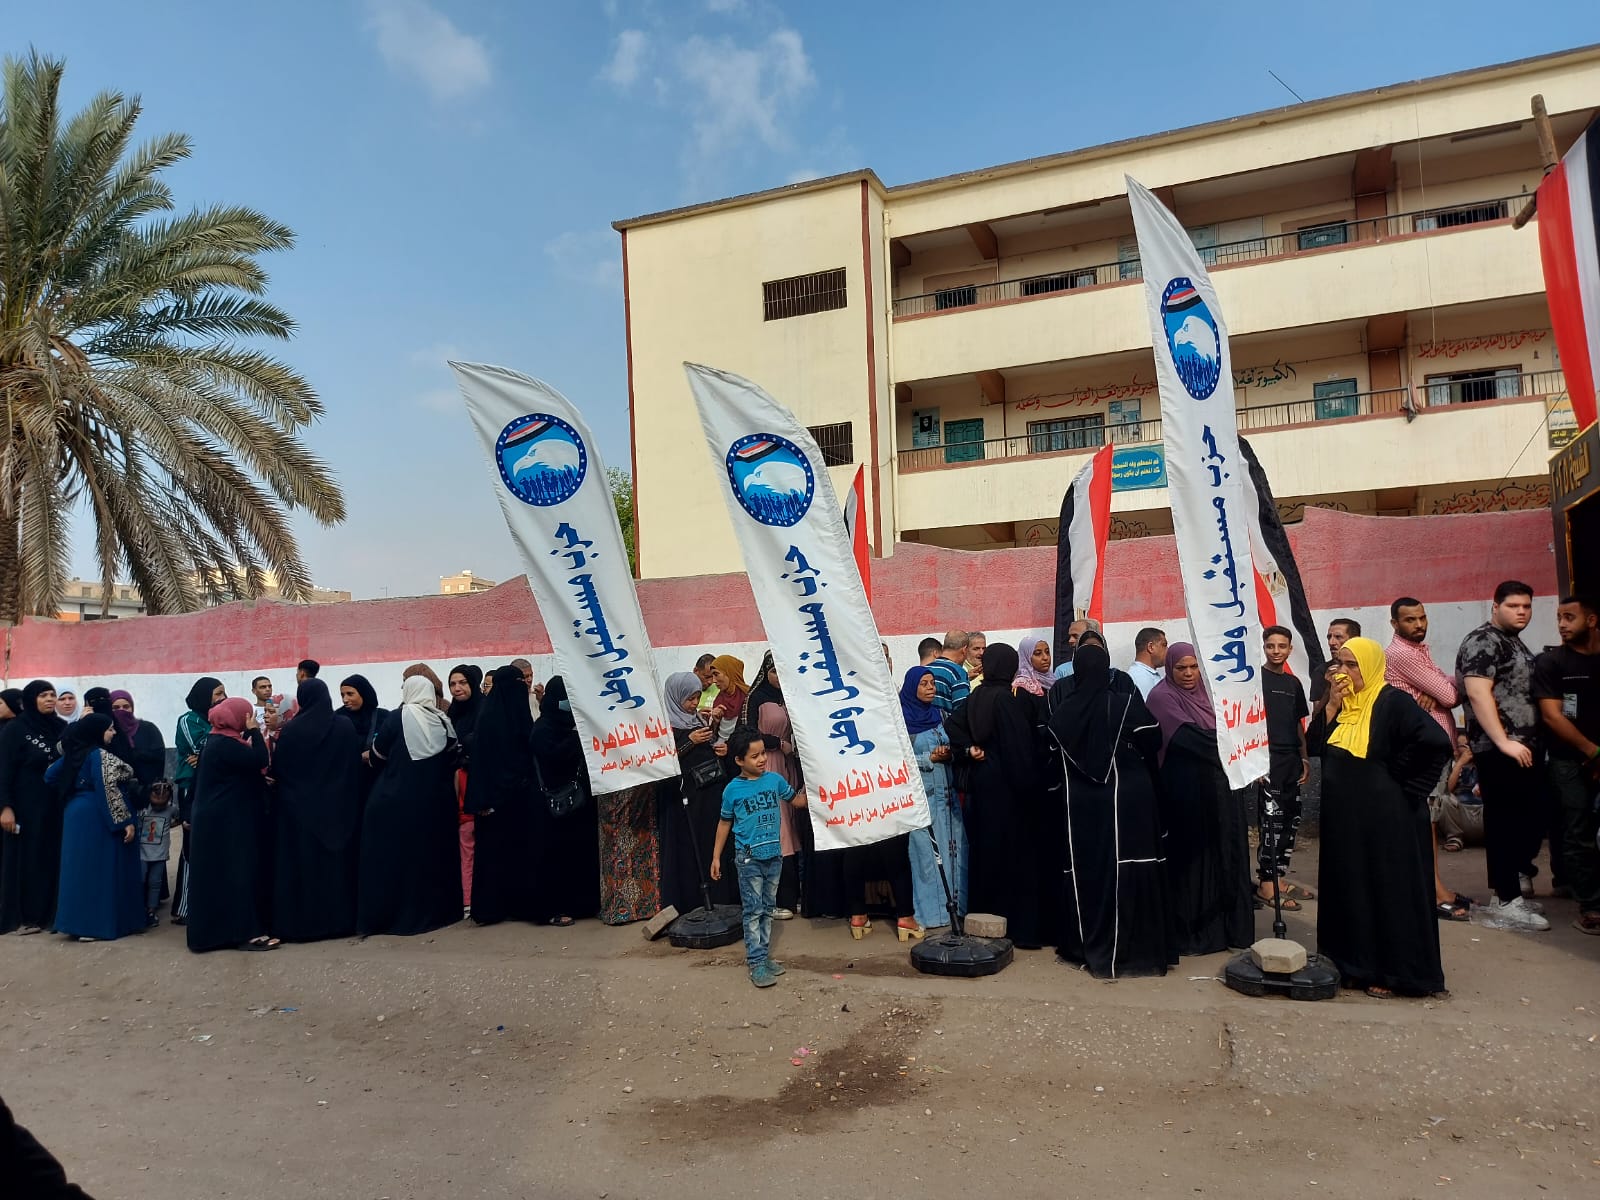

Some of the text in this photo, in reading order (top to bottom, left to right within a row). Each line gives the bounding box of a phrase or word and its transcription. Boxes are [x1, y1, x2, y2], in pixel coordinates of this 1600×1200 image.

[1254, 358, 1297, 388] الكمبيوتر
[1201, 424, 1230, 487] حزب
[1202, 497, 1246, 618] مستقبل
[549, 522, 646, 711] حزب مستقبل وطن
[780, 544, 875, 755] حزب مستقبل وطن
[1207, 625, 1255, 682] وطن
[592, 723, 641, 757] القاهره
[636, 754, 646, 768] من
[600, 760, 617, 774] مصر
[619, 755, 634, 771] اجل
[818, 759, 910, 810] امانه القاهره
[825, 793, 914, 828] كلنا نعمل من اجل مصر
